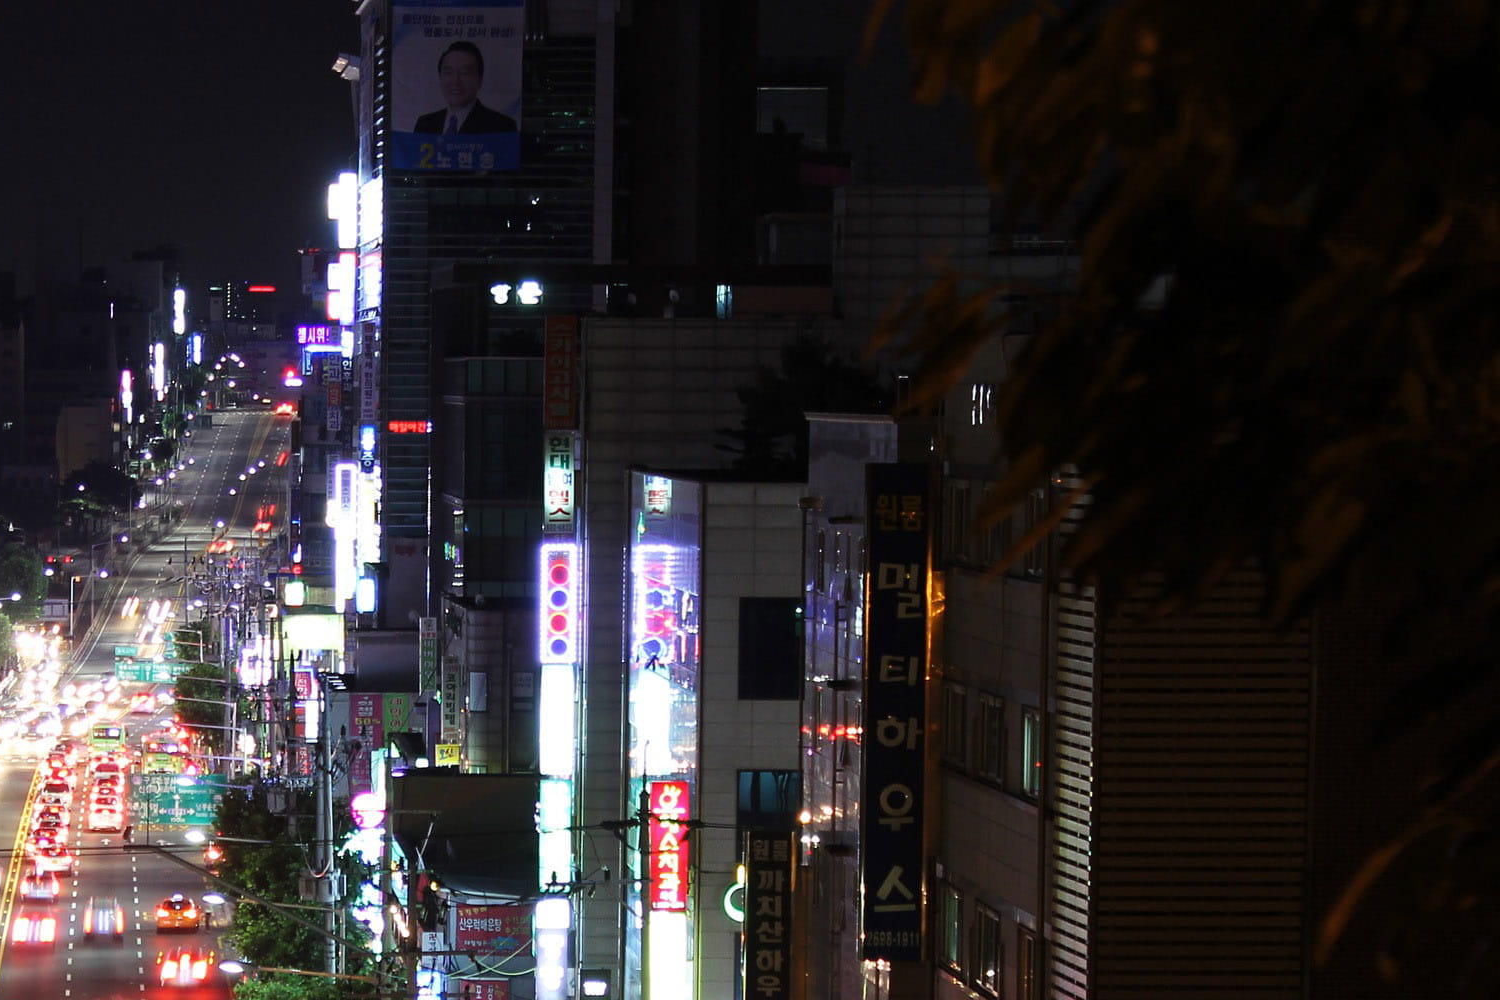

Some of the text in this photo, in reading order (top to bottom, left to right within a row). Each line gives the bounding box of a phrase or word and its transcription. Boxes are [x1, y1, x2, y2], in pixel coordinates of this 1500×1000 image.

[419, 143, 435, 169] 2
[876, 493, 924, 532] 원룸
[874, 561, 925, 912] 멀티하우스
